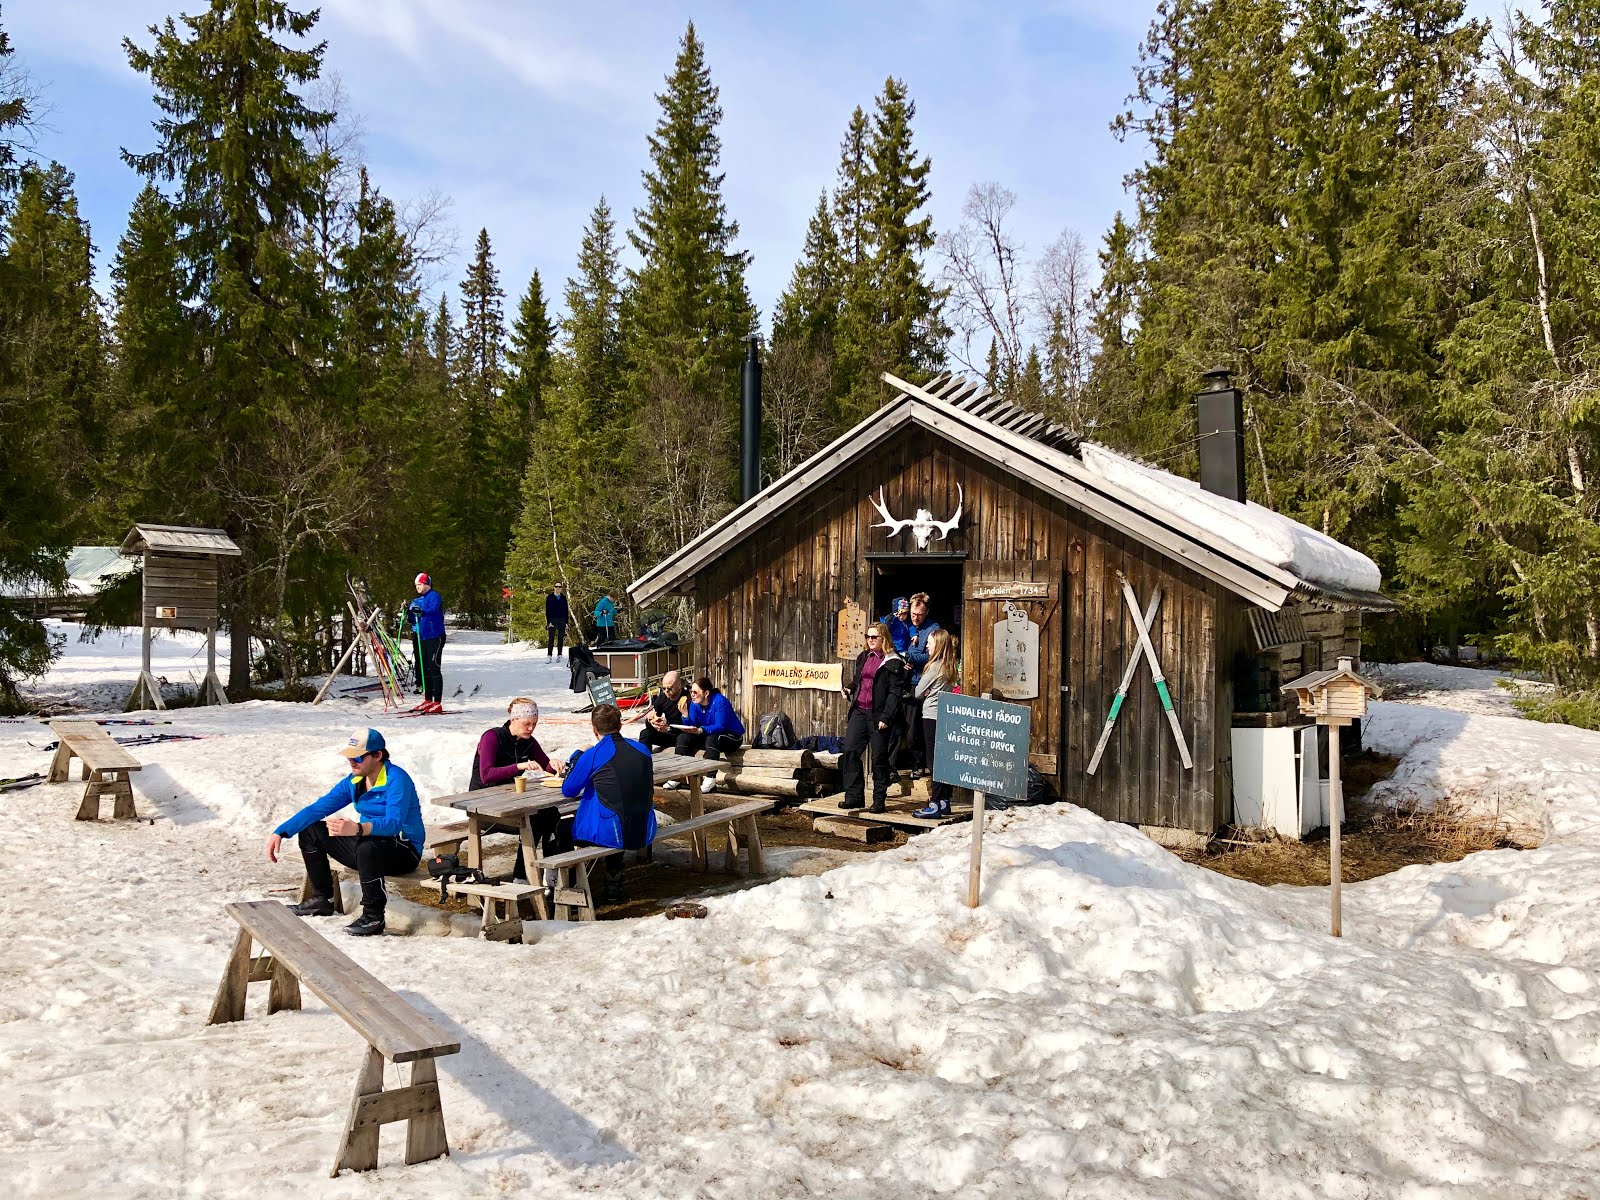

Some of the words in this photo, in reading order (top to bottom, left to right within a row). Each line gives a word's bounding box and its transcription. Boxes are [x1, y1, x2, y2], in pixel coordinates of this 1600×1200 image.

[979, 585, 1011, 595] Lindalen
[1019, 586, 1039, 595] 1734
[763, 668, 802, 678] LINDALENS
[946, 704, 993, 720] LINDALENS
[995, 709, 1021, 725] FÄBOD
[960, 723, 1006, 739] SERVERING
[954, 750, 978, 765] ÖPPET
[959, 772, 1004, 789] VÄLKOMMEN
